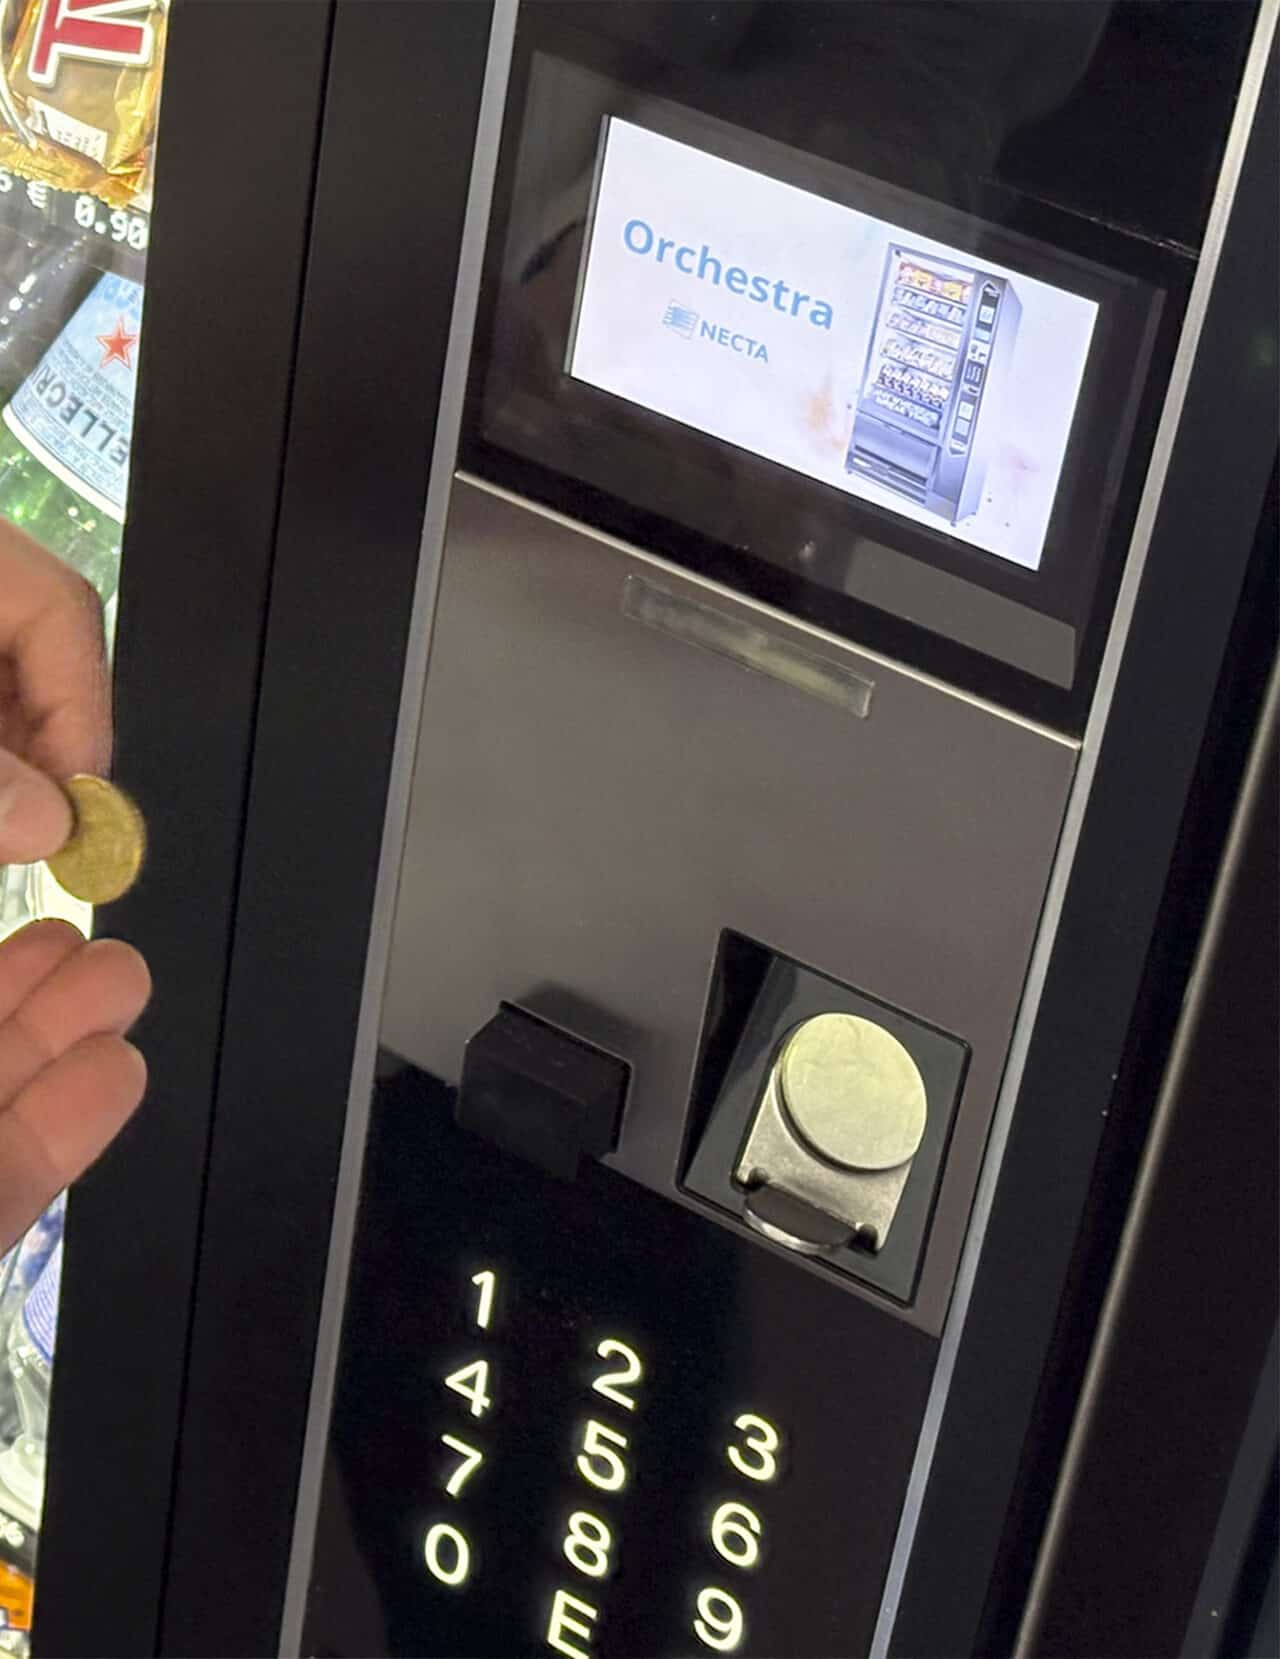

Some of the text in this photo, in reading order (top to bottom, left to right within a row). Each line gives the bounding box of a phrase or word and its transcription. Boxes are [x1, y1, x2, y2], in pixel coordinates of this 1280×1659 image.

[26, 180, 49, 209] €
[74, 194, 148, 249] 0.90
[623, 219, 834, 330] Orchestra
[700, 319, 769, 363] NECTA
[29, 364, 128, 467] ELLEGRI
[472, 1271, 778, 1480] 1 2 3
[445, 1360, 760, 1567] 4 5 6
[425, 1524, 597, 1659] 0 E
[442, 1435, 743, 1651] 7 8 9
